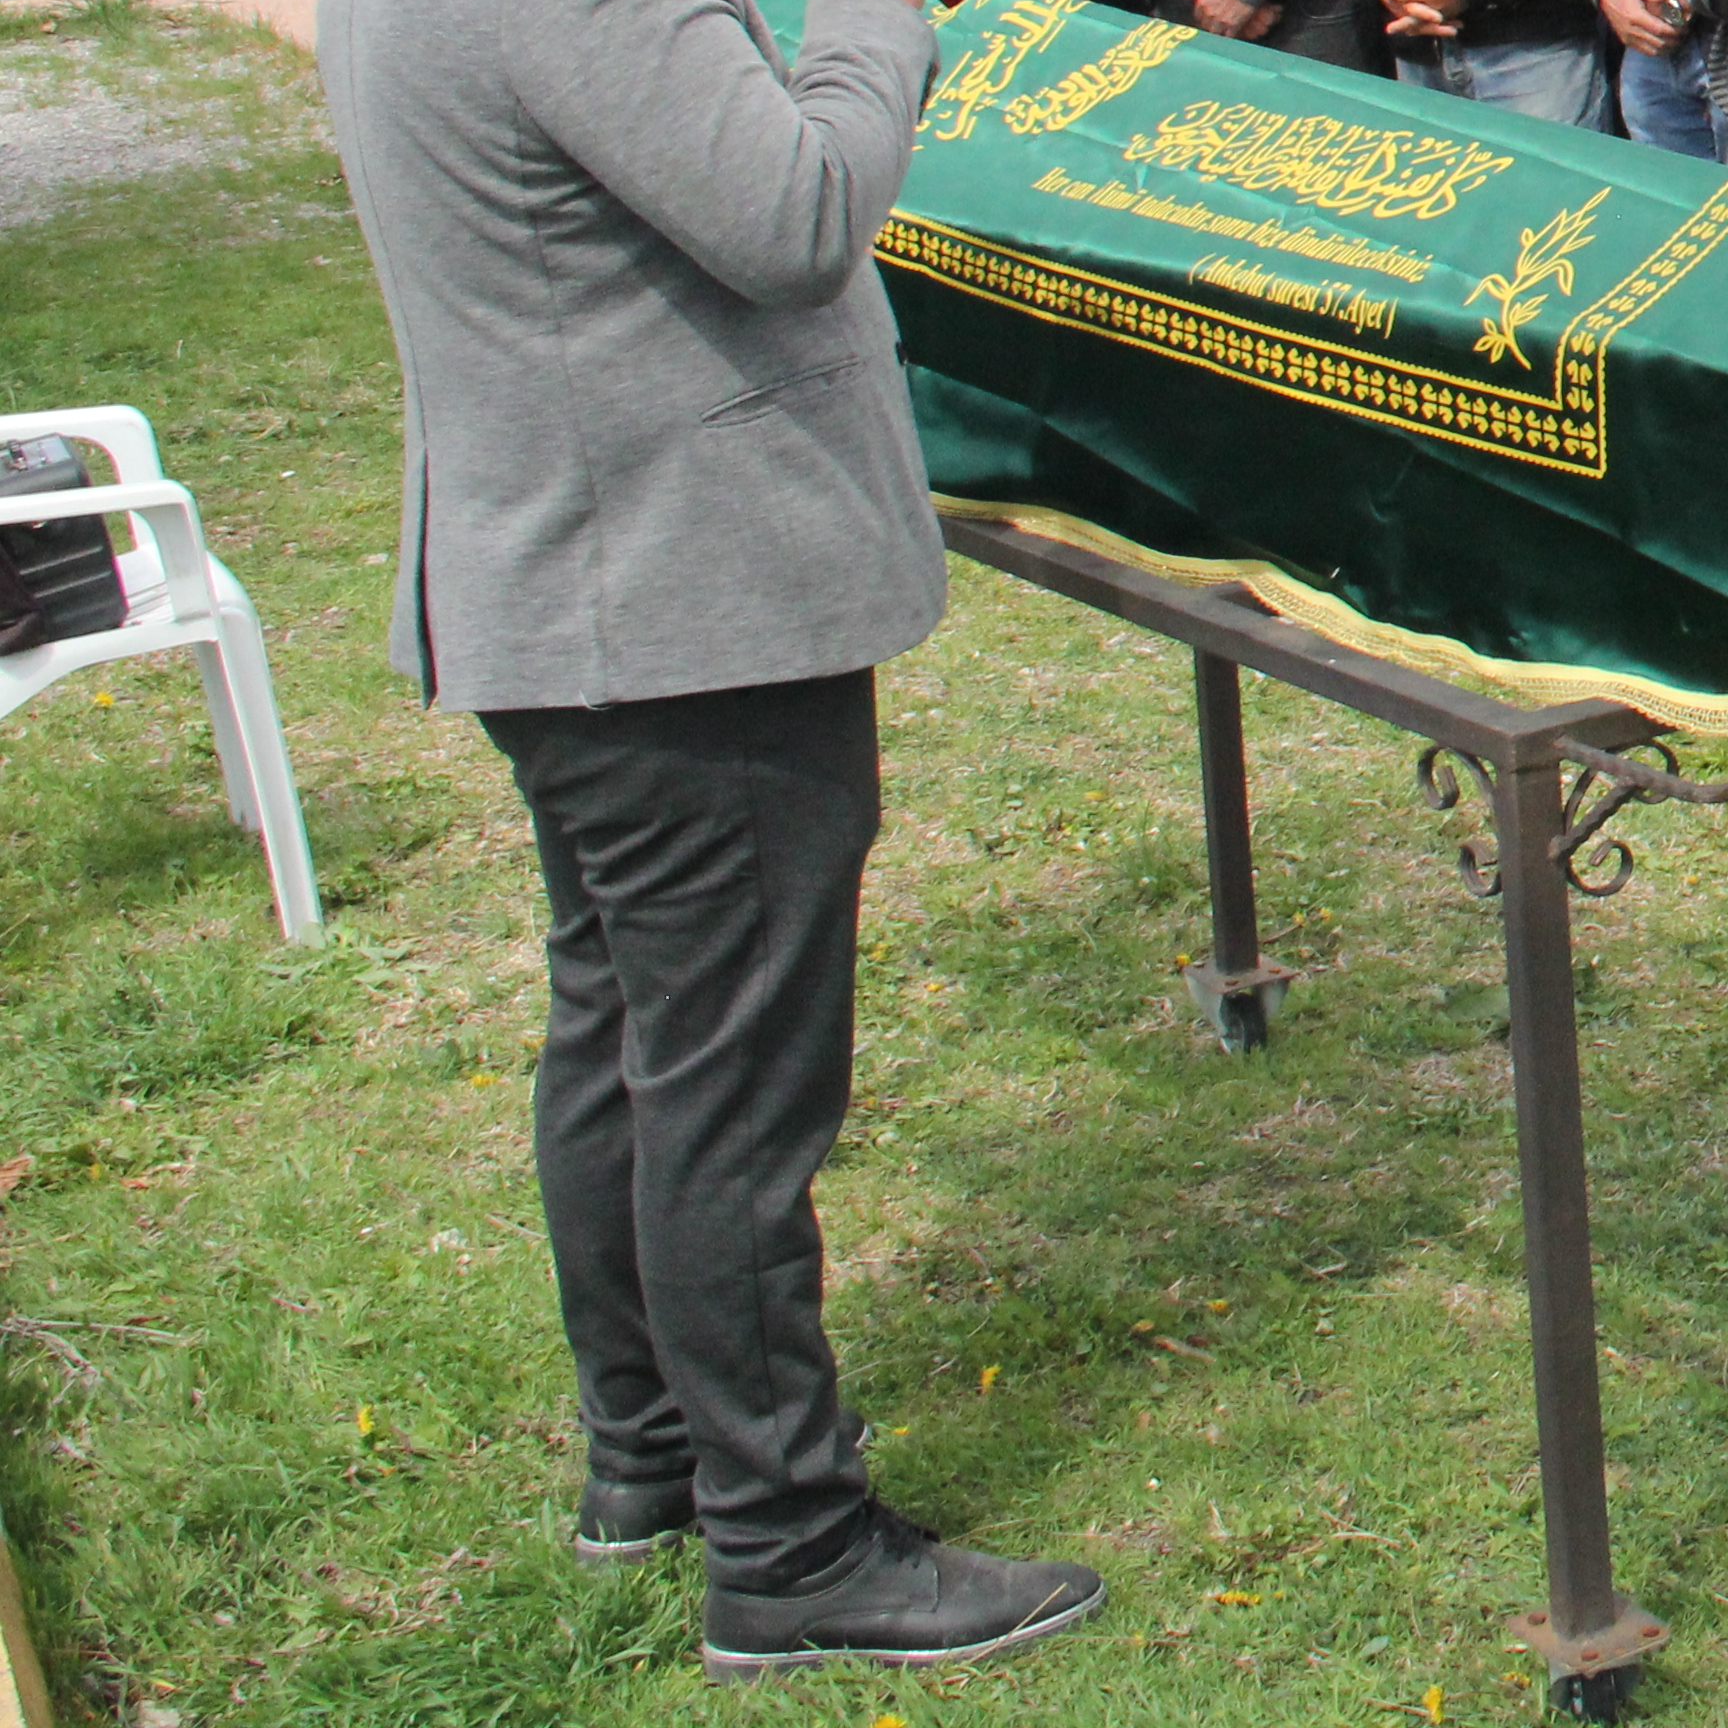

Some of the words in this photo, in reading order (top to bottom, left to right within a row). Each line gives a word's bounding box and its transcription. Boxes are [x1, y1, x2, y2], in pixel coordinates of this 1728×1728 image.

[1031, 166, 1072, 194] Her
[1059, 180, 1097, 201] can
[1246, 218, 1290, 248] bize
[1198, 255, 1277, 298] Ankebut
